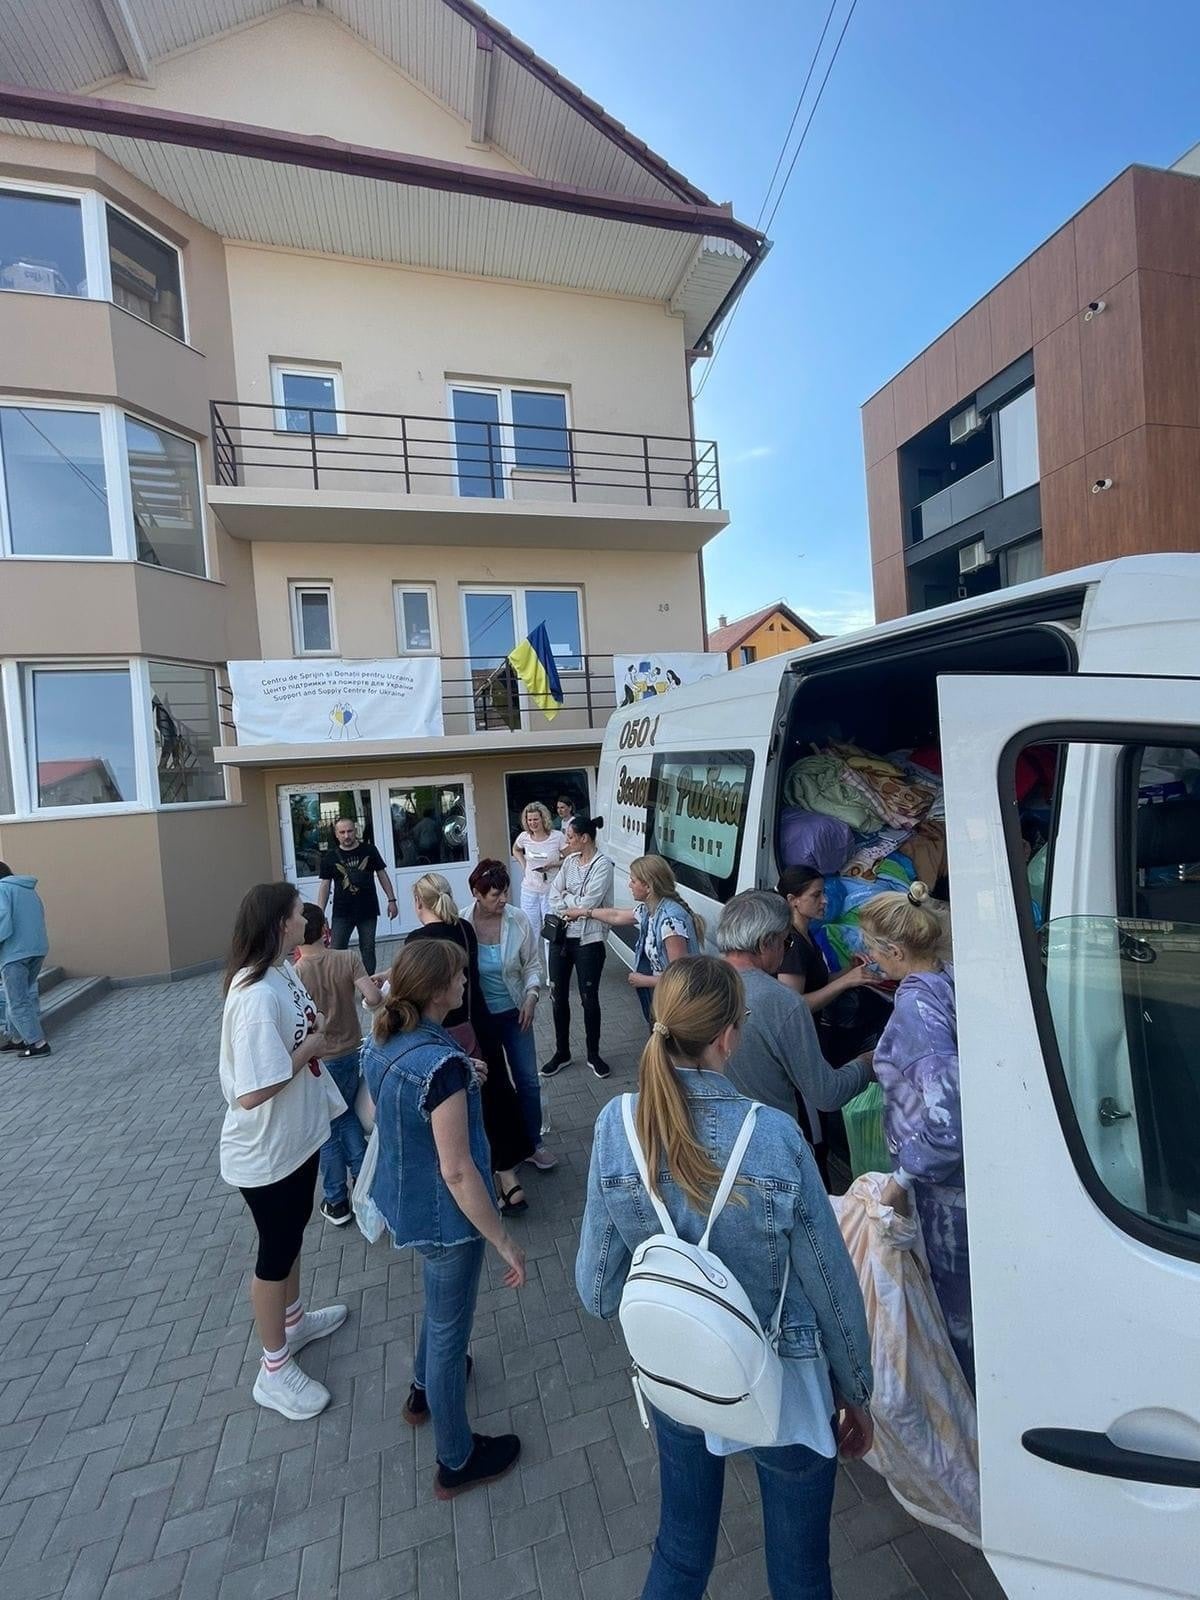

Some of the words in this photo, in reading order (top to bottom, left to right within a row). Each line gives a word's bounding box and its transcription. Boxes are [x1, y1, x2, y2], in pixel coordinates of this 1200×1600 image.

[261, 676, 287, 687] Centru
[299, 671, 324, 680] Sprijin
[361, 671, 386, 679] pentru
[387, 673, 414, 683] Ucraina
[263, 685, 287, 696] Центр
[288, 680, 327, 690] підтримки
[273, 690, 302, 702] Support
[303, 688, 317, 697] and
[317, 687, 342, 696] Supply
[343, 686, 367, 695] Centre
[368, 687, 378, 695] for
[379, 688, 406, 698] Ukraine
